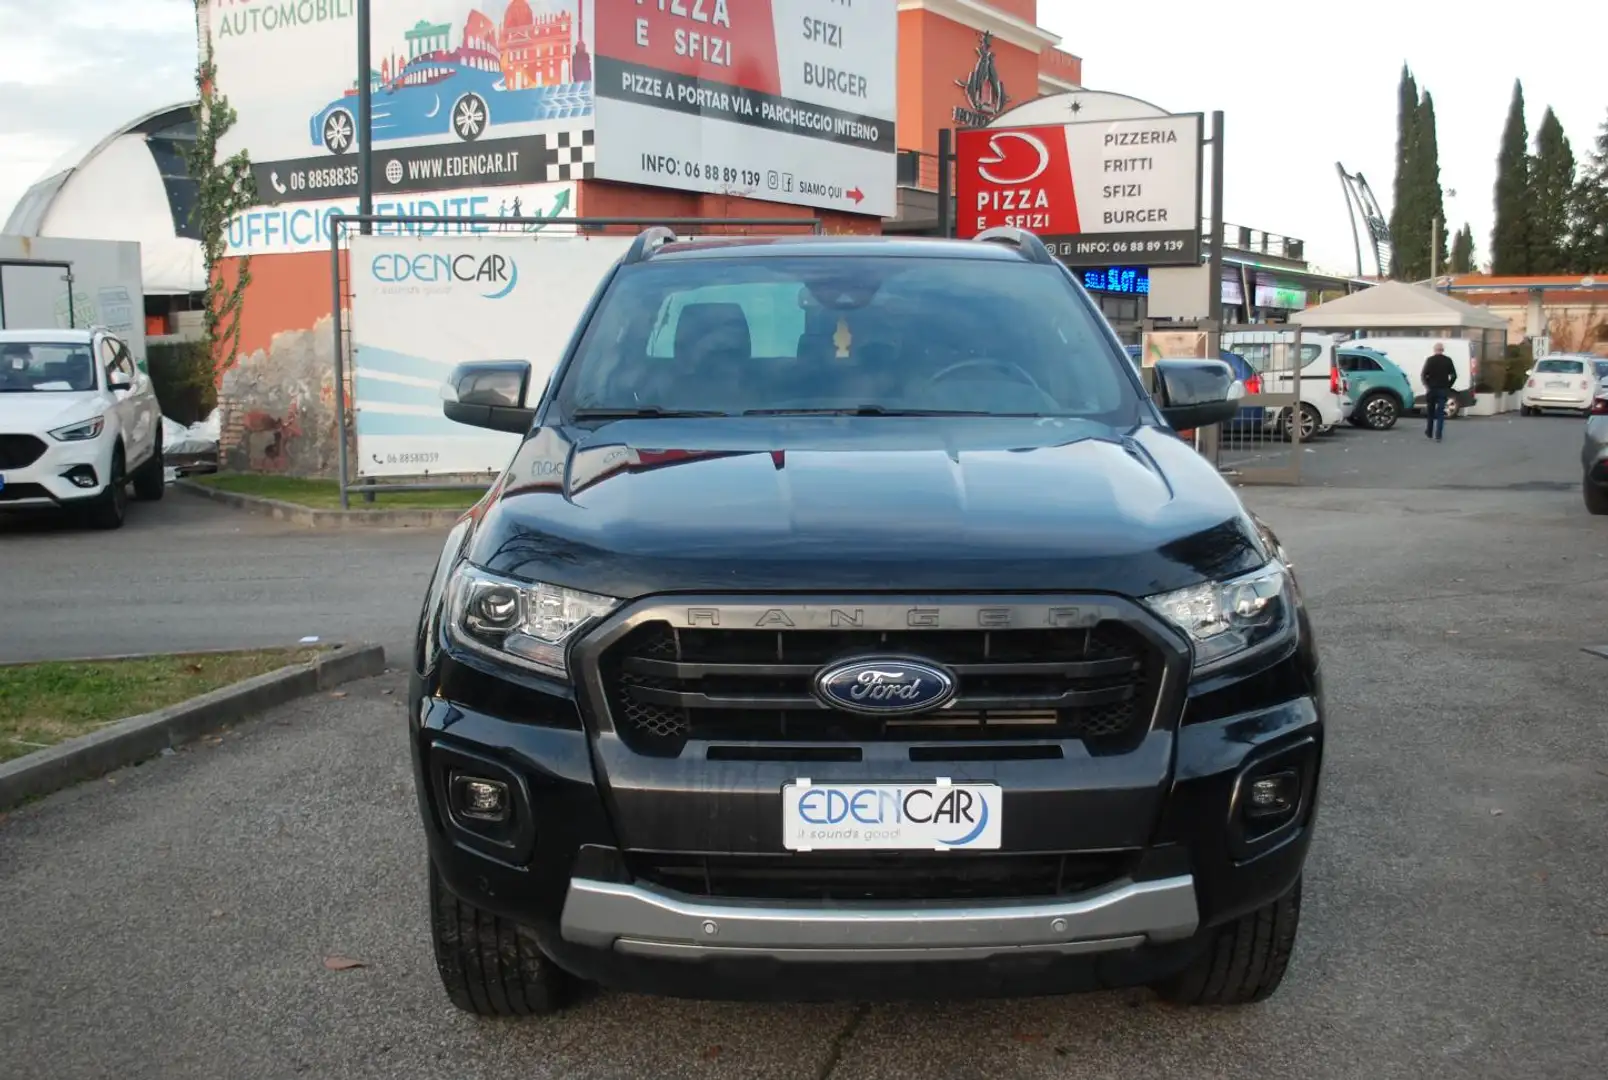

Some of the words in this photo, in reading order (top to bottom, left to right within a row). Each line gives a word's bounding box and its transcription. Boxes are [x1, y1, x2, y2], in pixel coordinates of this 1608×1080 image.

[219, 0, 354, 38] AUTOMOBILI
[802, 16, 842, 49] SFIZI
[636, 18, 649, 46] E
[674, 28, 731, 66] SFIZI
[803, 61, 867, 99] BURGER
[622, 72, 662, 98] PIZZE
[665, 82, 675, 101] A
[678, 84, 729, 112] PORTAR
[731, 95, 753, 116] VIA
[761, 102, 832, 132] PARCHEGGIO
[834, 118, 878, 142] INTERNO
[1104, 130, 1177, 146] PIZZERIA
[290, 172, 306, 190] 06
[308, 166, 360, 188] 8858835
[408, 152, 519, 180] WWW.EDENCAR.IT
[641, 153, 680, 176] INFO:
[684, 161, 700, 178] 06
[704, 165, 719, 181] 88
[723, 167, 738, 184] 89
[741, 170, 761, 186] 139
[799, 180, 826, 196] SIAMO
[828, 185, 842, 199] QUI
[1104, 157, 1153, 172] FRITTI
[977, 188, 1049, 212] PIZZA
[1103, 184, 1142, 198] SFIZI
[229, 206, 346, 248] UFFICIO
[357, 196, 489, 237] ENDITE
[977, 216, 987, 230] E
[1005, 214, 1050, 229] SFIZI
[1103, 208, 1168, 224] BURGER
[1077, 242, 1110, 254] INFO:
[1112, 242, 1127, 253] 06
[1130, 242, 1144, 252] 88
[1146, 241, 1160, 251] 89
[1164, 240, 1183, 251] 139
[372, 253, 508, 283] EDENCAR
[688, 607, 1080, 627] RANGER
[849, 670, 921, 701] Ford
[799, 789, 975, 824] EDENCAR
[809, 828, 859, 840] sounds
